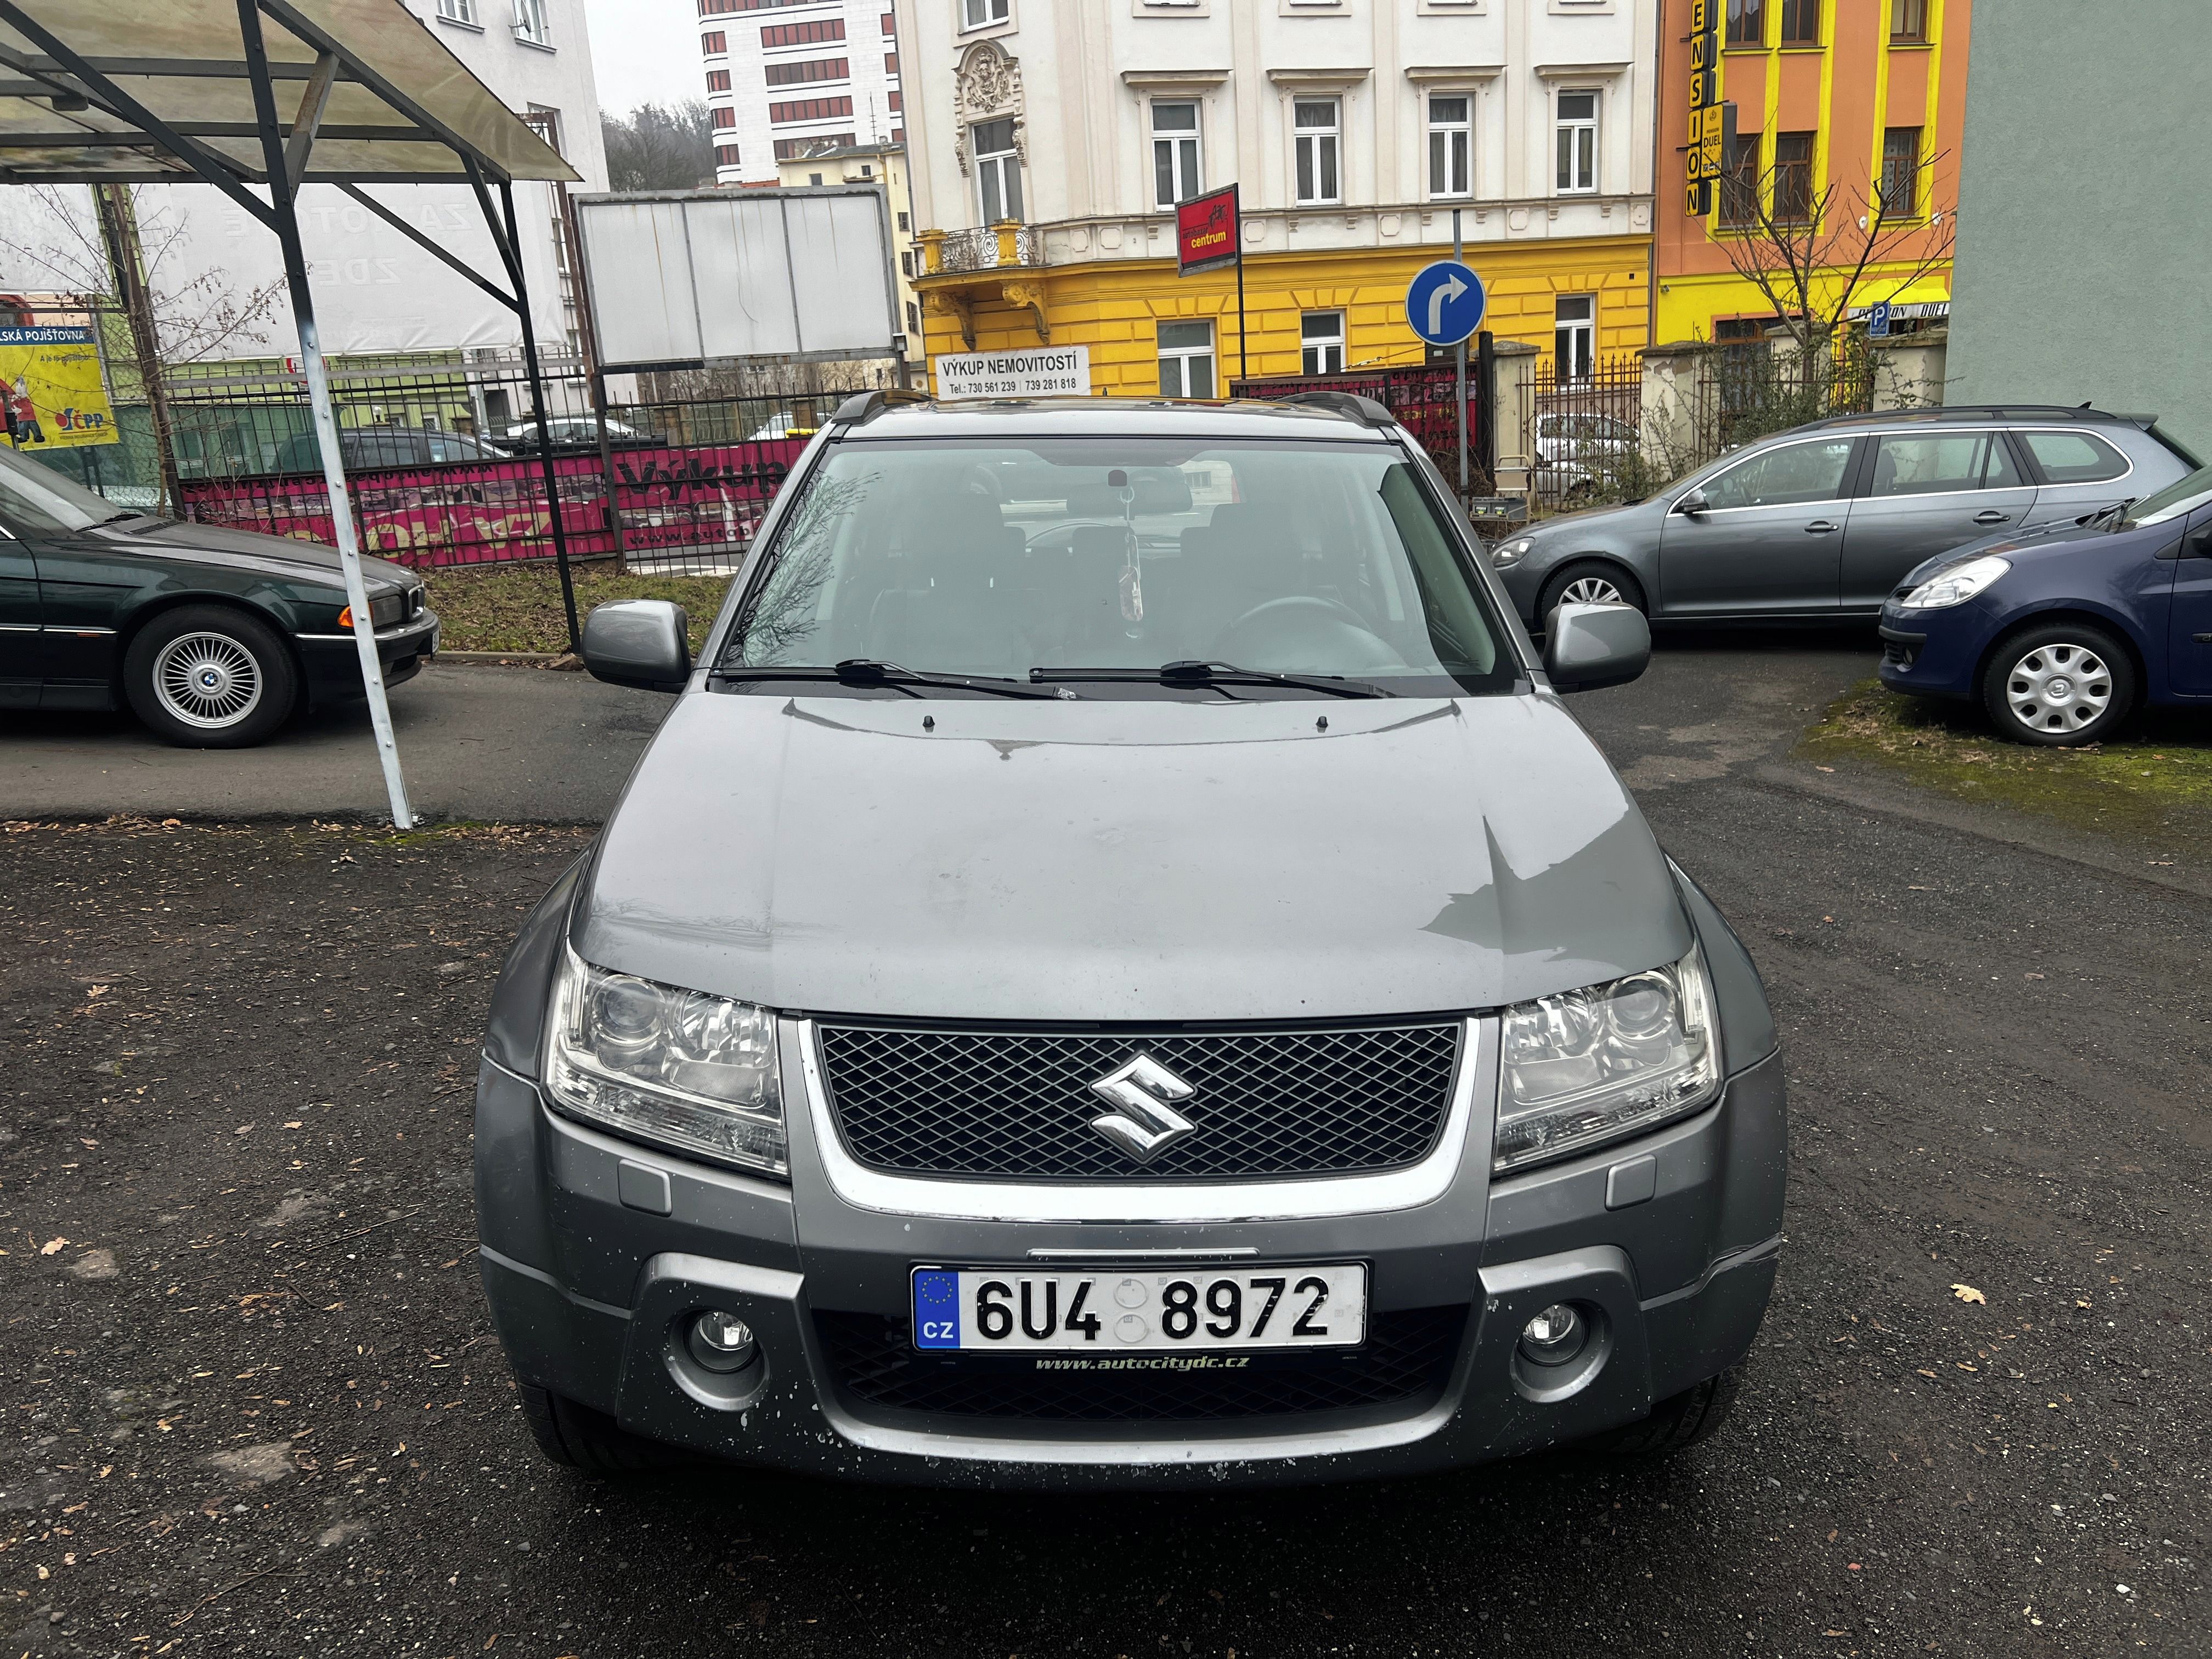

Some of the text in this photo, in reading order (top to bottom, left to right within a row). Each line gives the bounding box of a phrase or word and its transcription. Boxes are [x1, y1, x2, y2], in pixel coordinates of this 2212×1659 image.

[1703, 134, 1721, 148] DUEL
[1191, 231, 1227, 249] centrum
[1921, 302, 1947, 317] DUEL
[943, 351, 1077, 376] VÝKUP NEMOVITOSTÍ
[950, 377, 1076, 394] Tel.: 730 561 239 739 281 818
[74, 409, 104, 429] ČPP
[617, 459, 788, 500] Výkup
[975, 1273, 1331, 1341] 6U4 8972
[922, 1322, 954, 1340] CZ
[1036, 1356, 1250, 1372] www.autocitydc.cz
